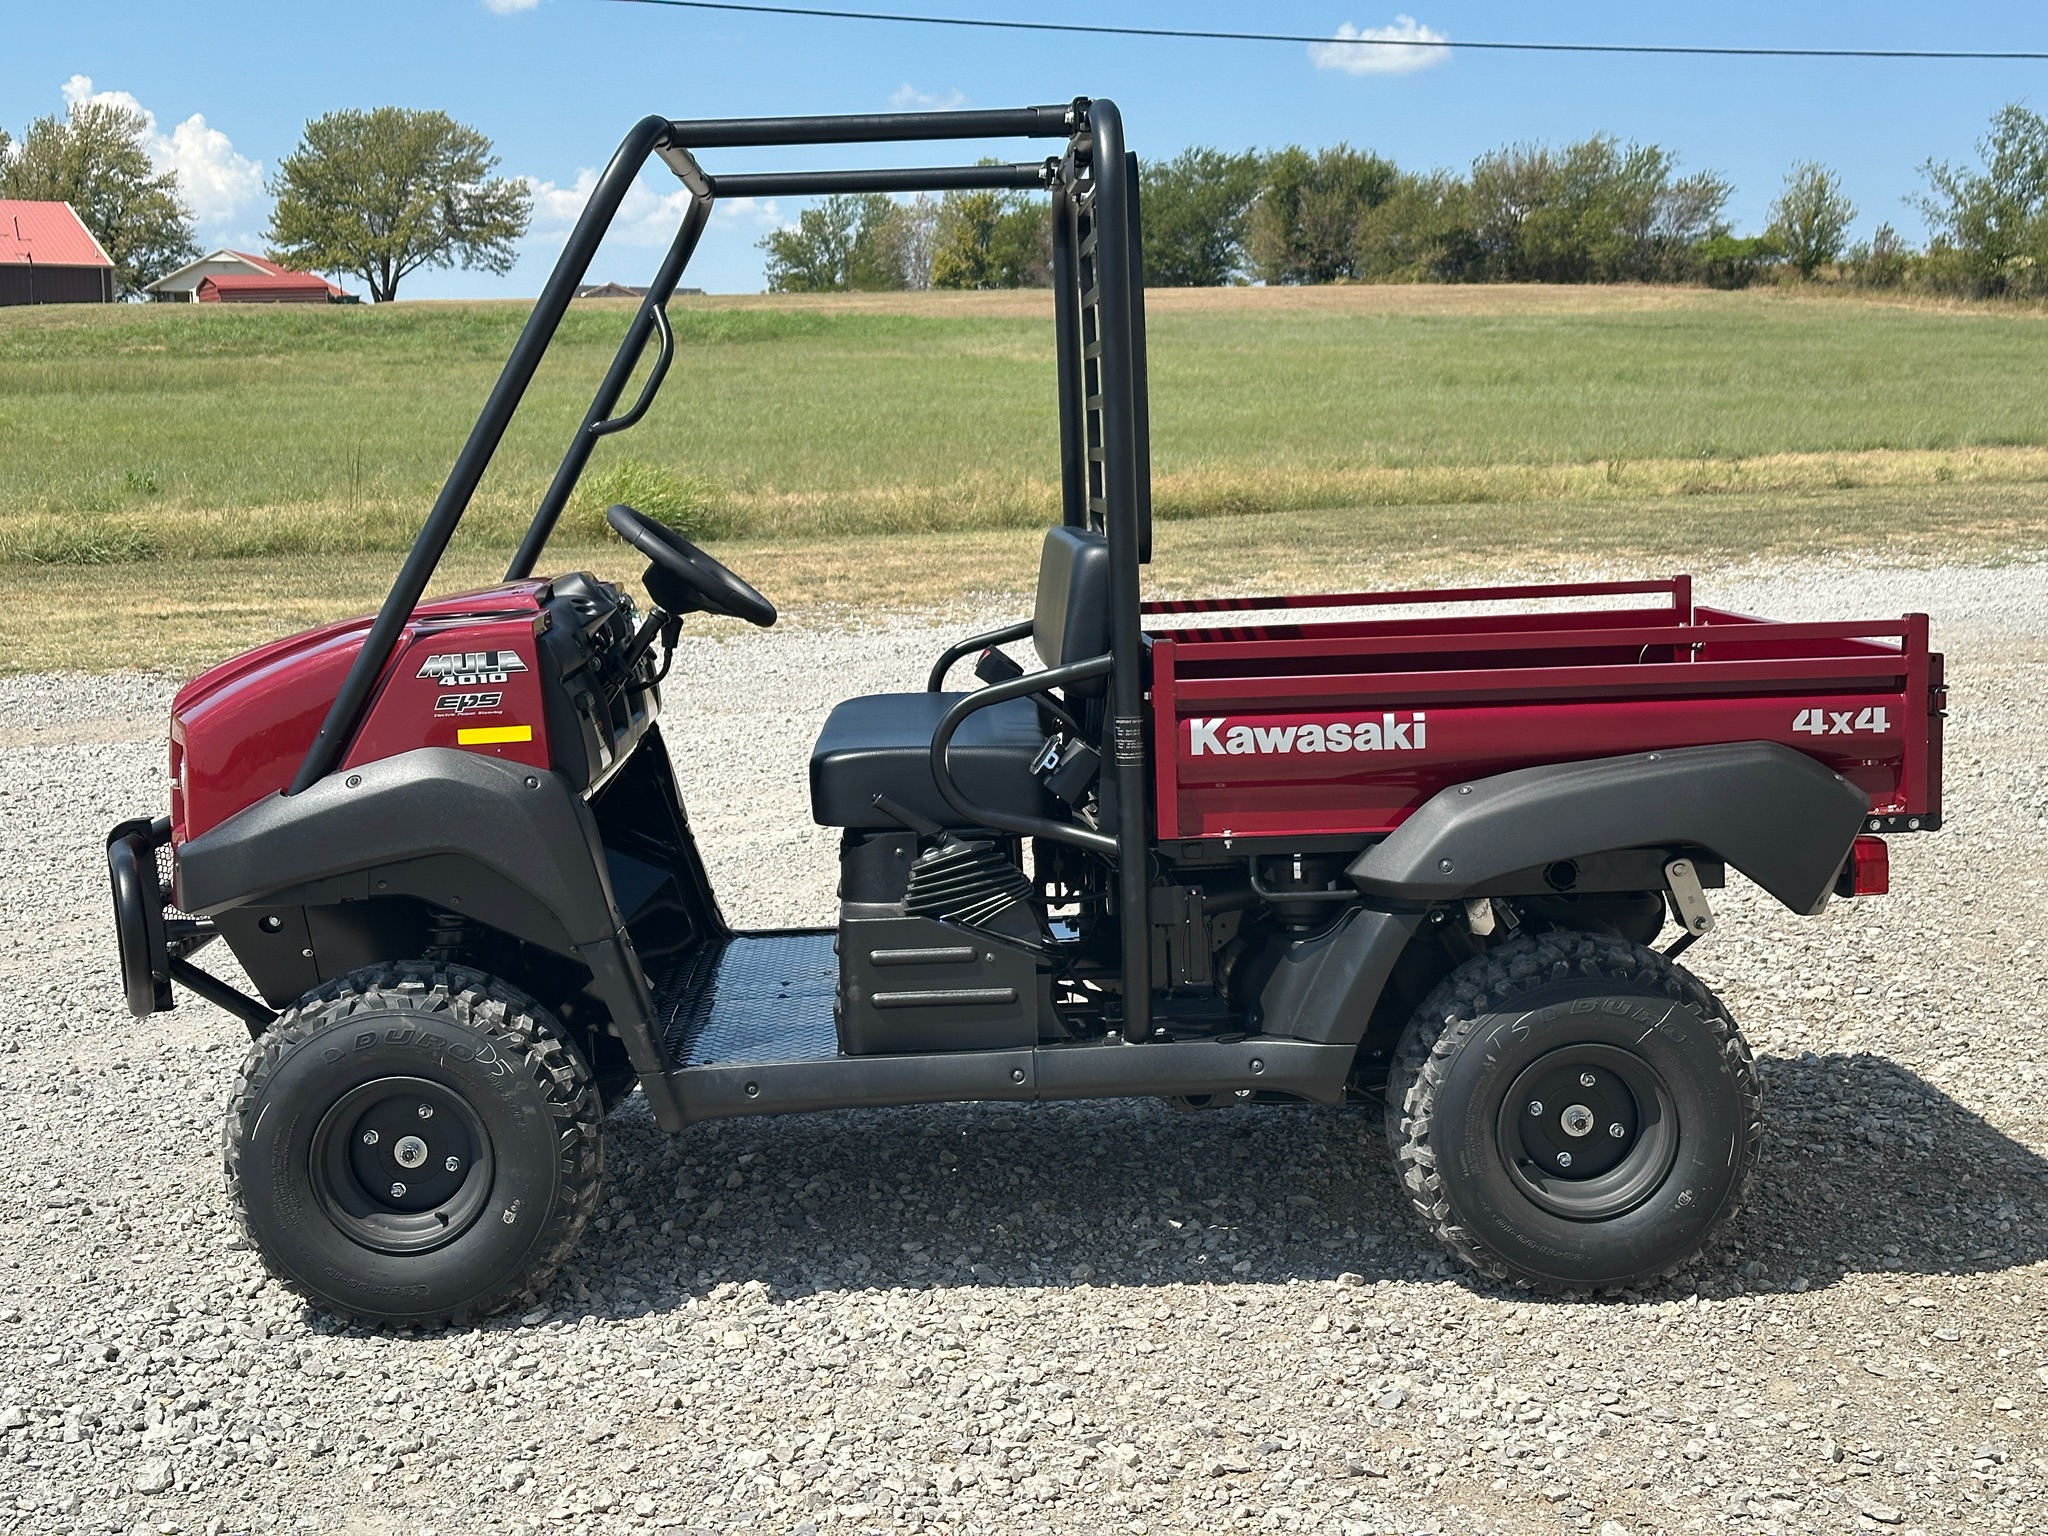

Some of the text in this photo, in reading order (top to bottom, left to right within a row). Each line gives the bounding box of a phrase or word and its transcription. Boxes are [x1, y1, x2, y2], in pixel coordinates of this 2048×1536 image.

[415, 650, 528, 678] MULE
[438, 672, 508, 686] 4010
[433, 691, 503, 713] EPS
[1189, 711, 1426, 756] Kawasaki
[1792, 706, 1891, 735] 4x4
[1570, 998, 1687, 1044] DURO
[353, 1028, 476, 1064] DURO
